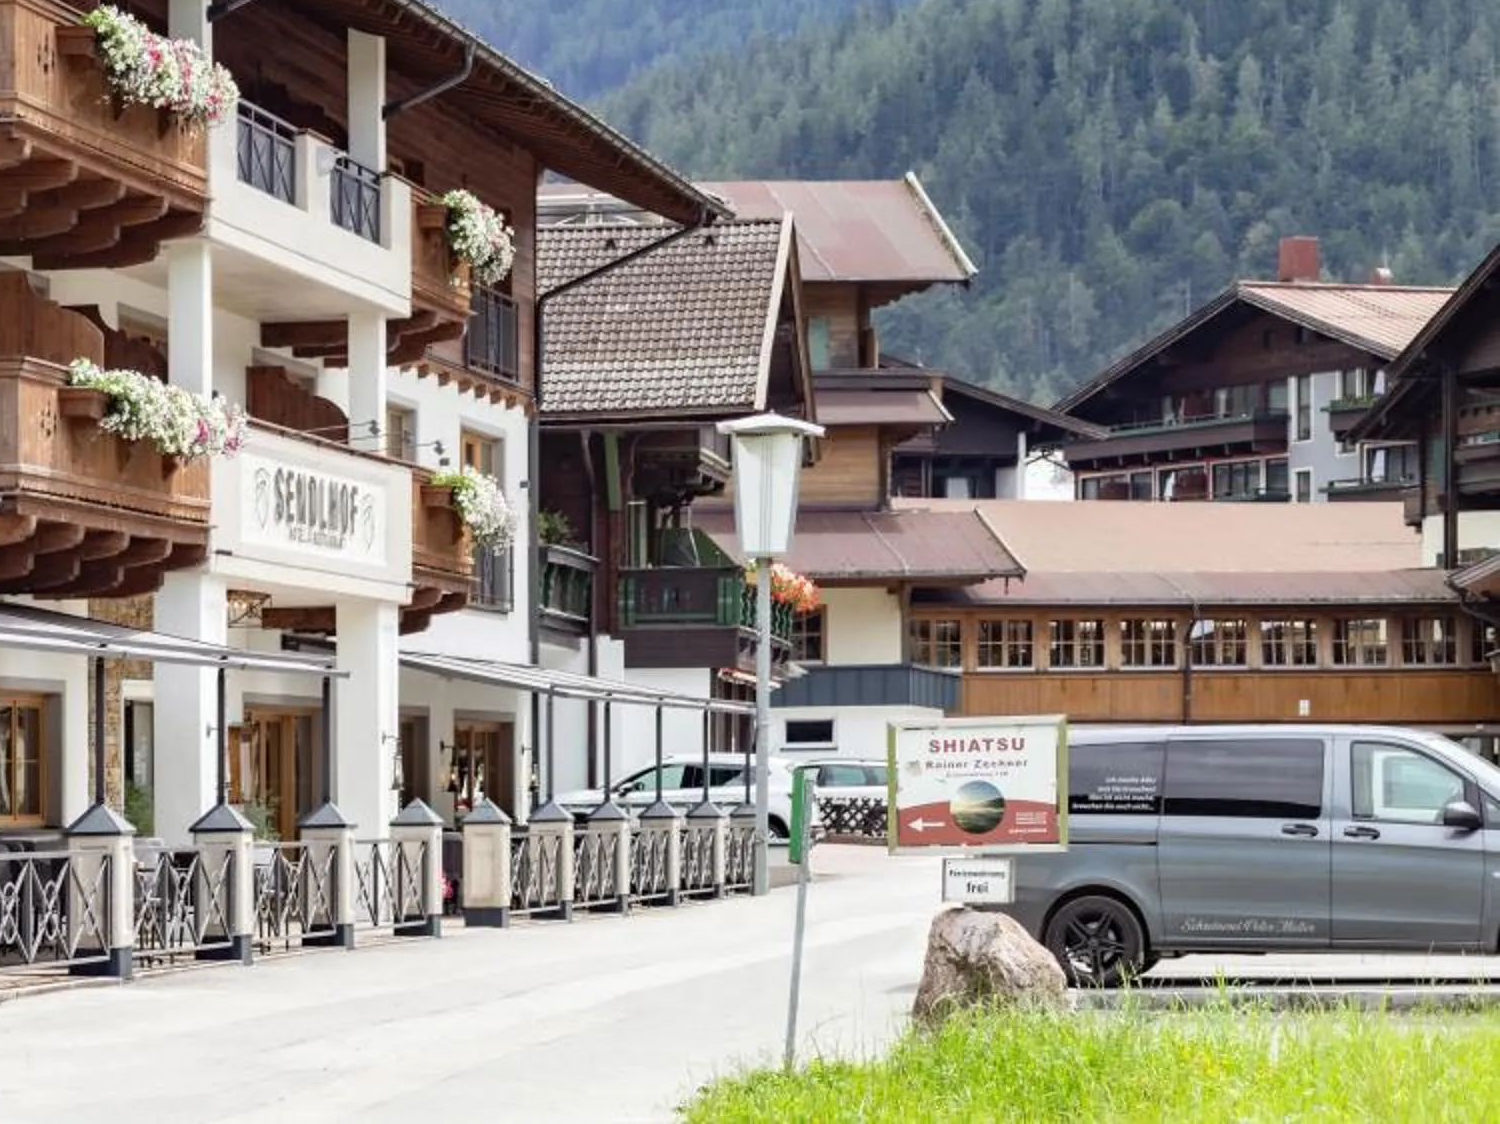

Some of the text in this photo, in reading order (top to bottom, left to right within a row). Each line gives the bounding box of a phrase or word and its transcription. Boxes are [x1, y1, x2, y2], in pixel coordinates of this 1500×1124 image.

[273, 467, 359, 535] SENDLHOF
[928, 737, 1025, 754] SHIATSU
[966, 880, 989, 893] frei
